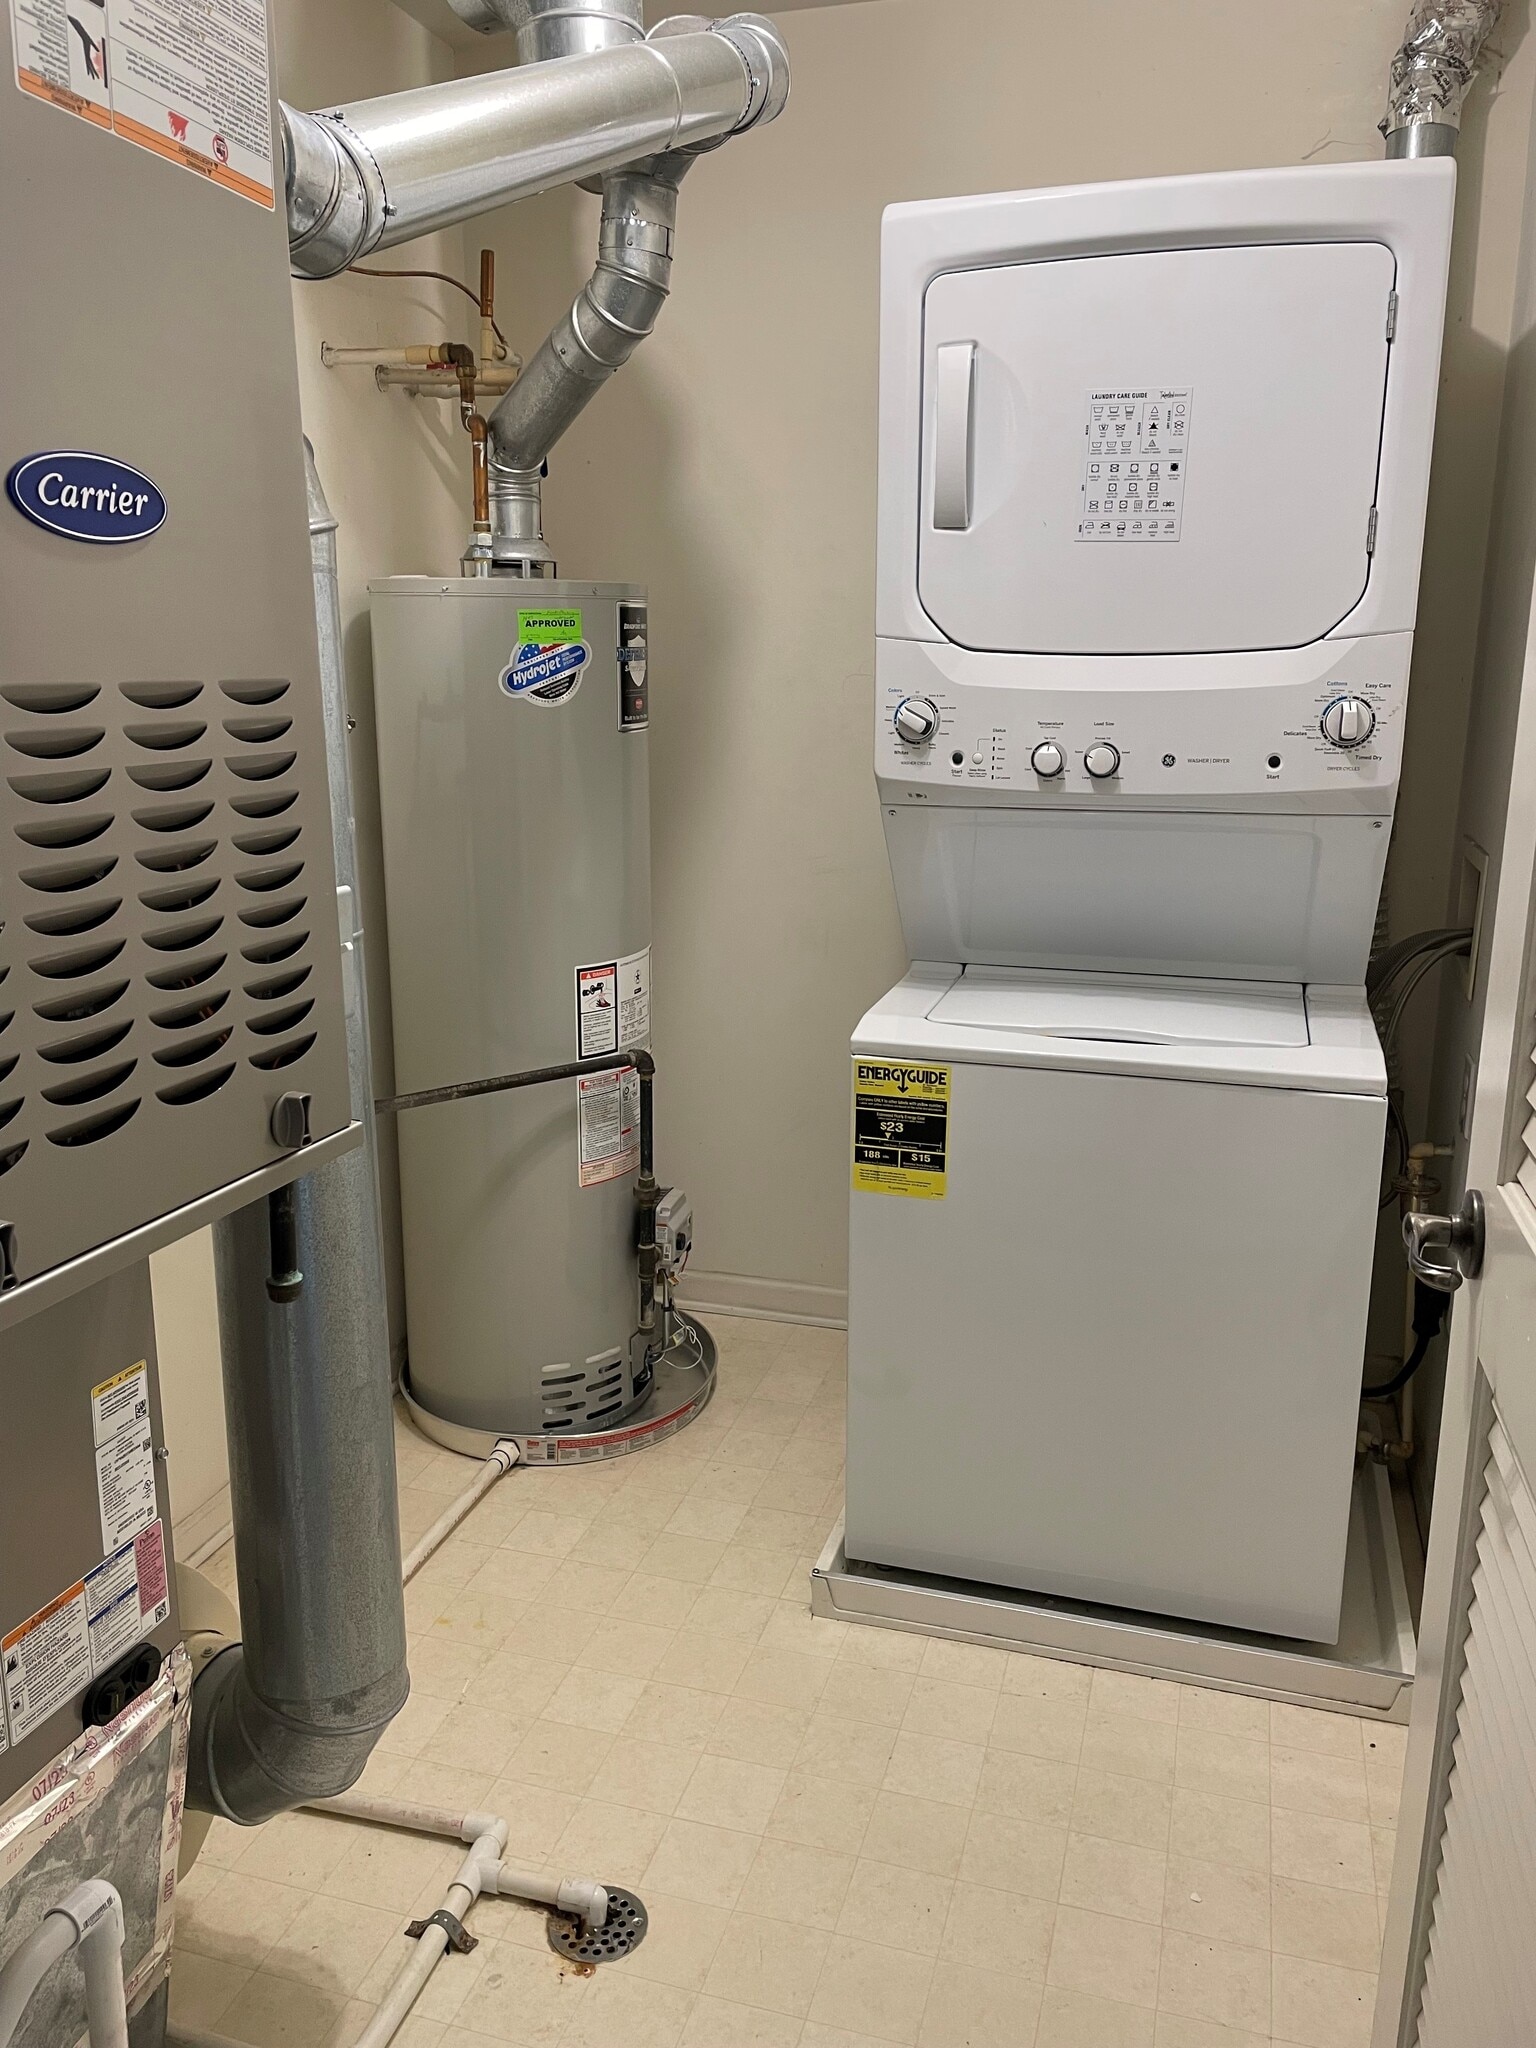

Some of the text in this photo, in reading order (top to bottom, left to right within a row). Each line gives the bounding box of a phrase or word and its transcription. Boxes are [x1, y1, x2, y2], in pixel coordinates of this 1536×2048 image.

[38, 472, 148, 516] Carrier
[525, 619, 576, 627] APPROVED
[513, 655, 561, 686] Hydrojet
[858, 1065, 947, 1085] ENERGYGUIDE
[880, 1121, 904, 1133] $23
[863, 1150, 881, 1159] 188
[911, 1153, 931, 1162] $15
[25, 1646, 50, 1669] EXPLOSION
[44, 1791, 75, 1825] 07/23
